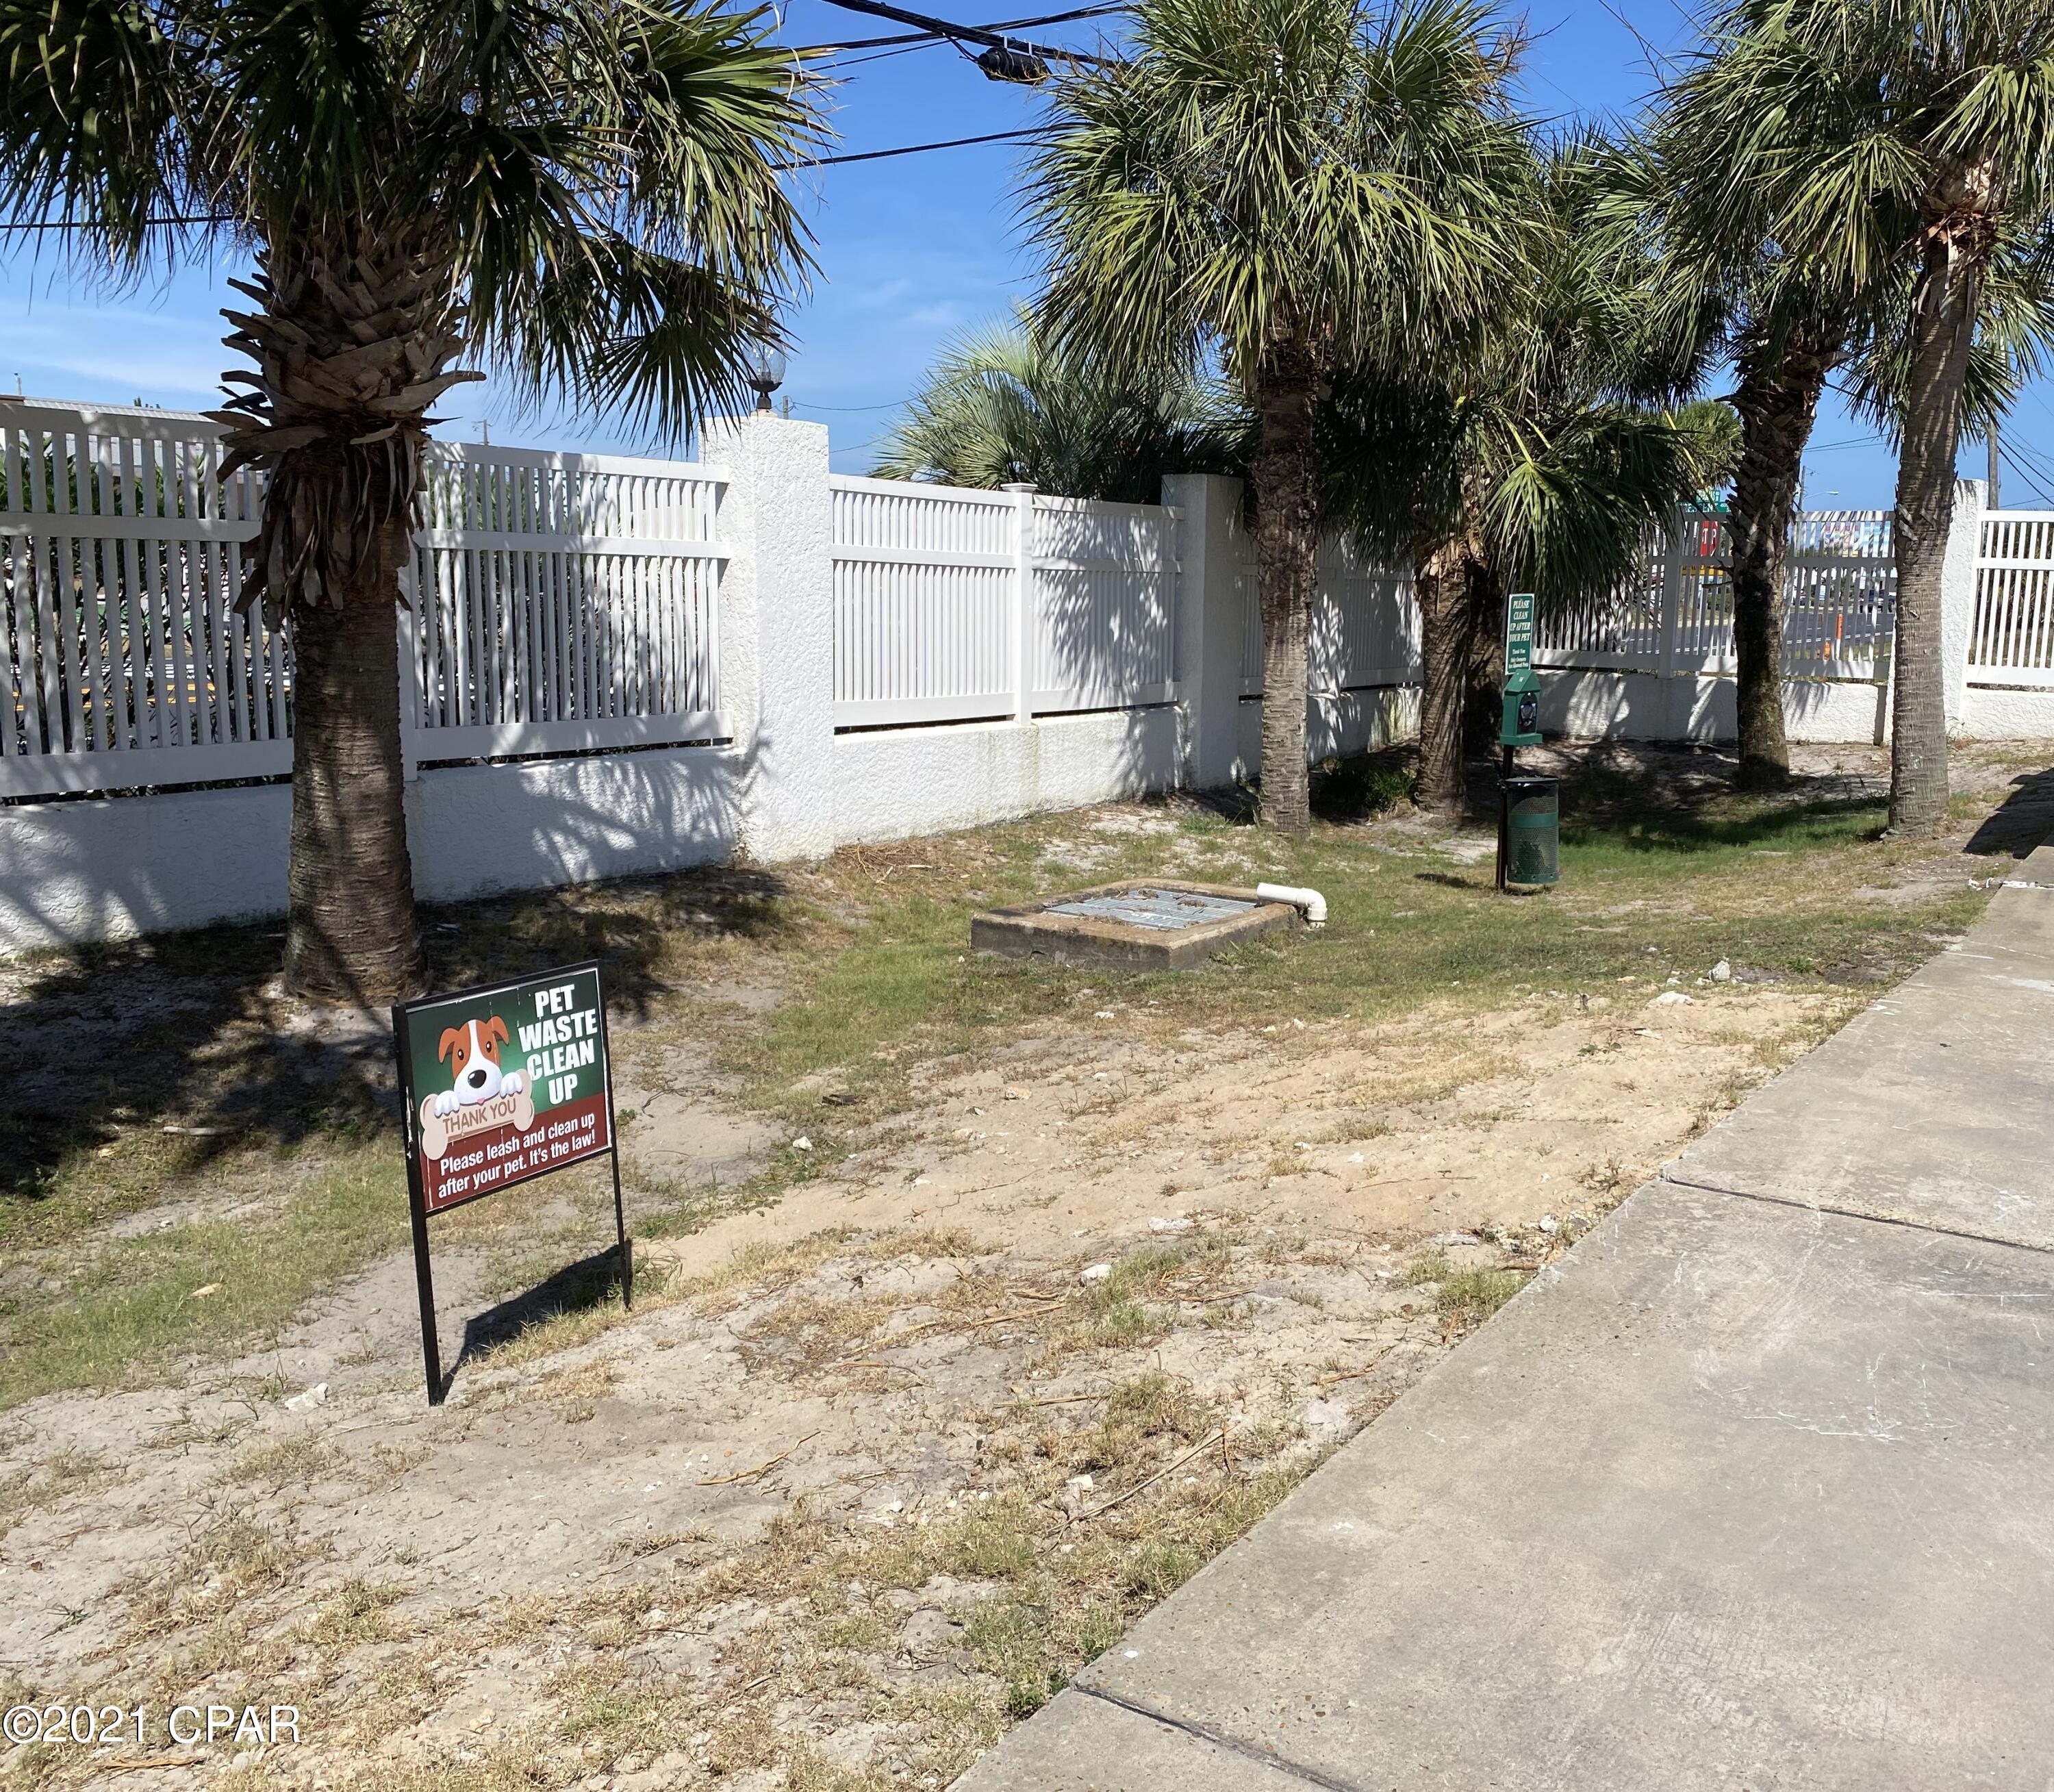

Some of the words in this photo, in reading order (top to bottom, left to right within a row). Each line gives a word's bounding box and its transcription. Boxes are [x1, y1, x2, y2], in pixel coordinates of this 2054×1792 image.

[1512, 601, 1530, 609] PLEASE
[1513, 611, 1528, 620] CLEAN
[1509, 633, 1521, 642] YOUR
[1521, 633, 1531, 641] PET
[1516, 622, 1531, 630] AFTER
[535, 984, 575, 1018] PET
[518, 1009, 598, 1053] WASTE
[527, 1039, 595, 1081] CLEAN
[548, 1074, 578, 1105] UP
[442, 1105, 487, 1135] THANK
[491, 1098, 516, 1120] YOU
[440, 1150, 483, 1176] Please
[487, 1137, 520, 1159] leash
[523, 1130, 545, 1152] and
[548, 1121, 578, 1144] clean
[581, 1113, 595, 1133] up
[438, 1175, 470, 1199] after
[472, 1165, 502, 1189] your
[504, 1159, 527, 1179] pet.
[530, 1148, 548, 1165] It's
[550, 1141, 570, 1159] the
[572, 1130, 596, 1152] law!
